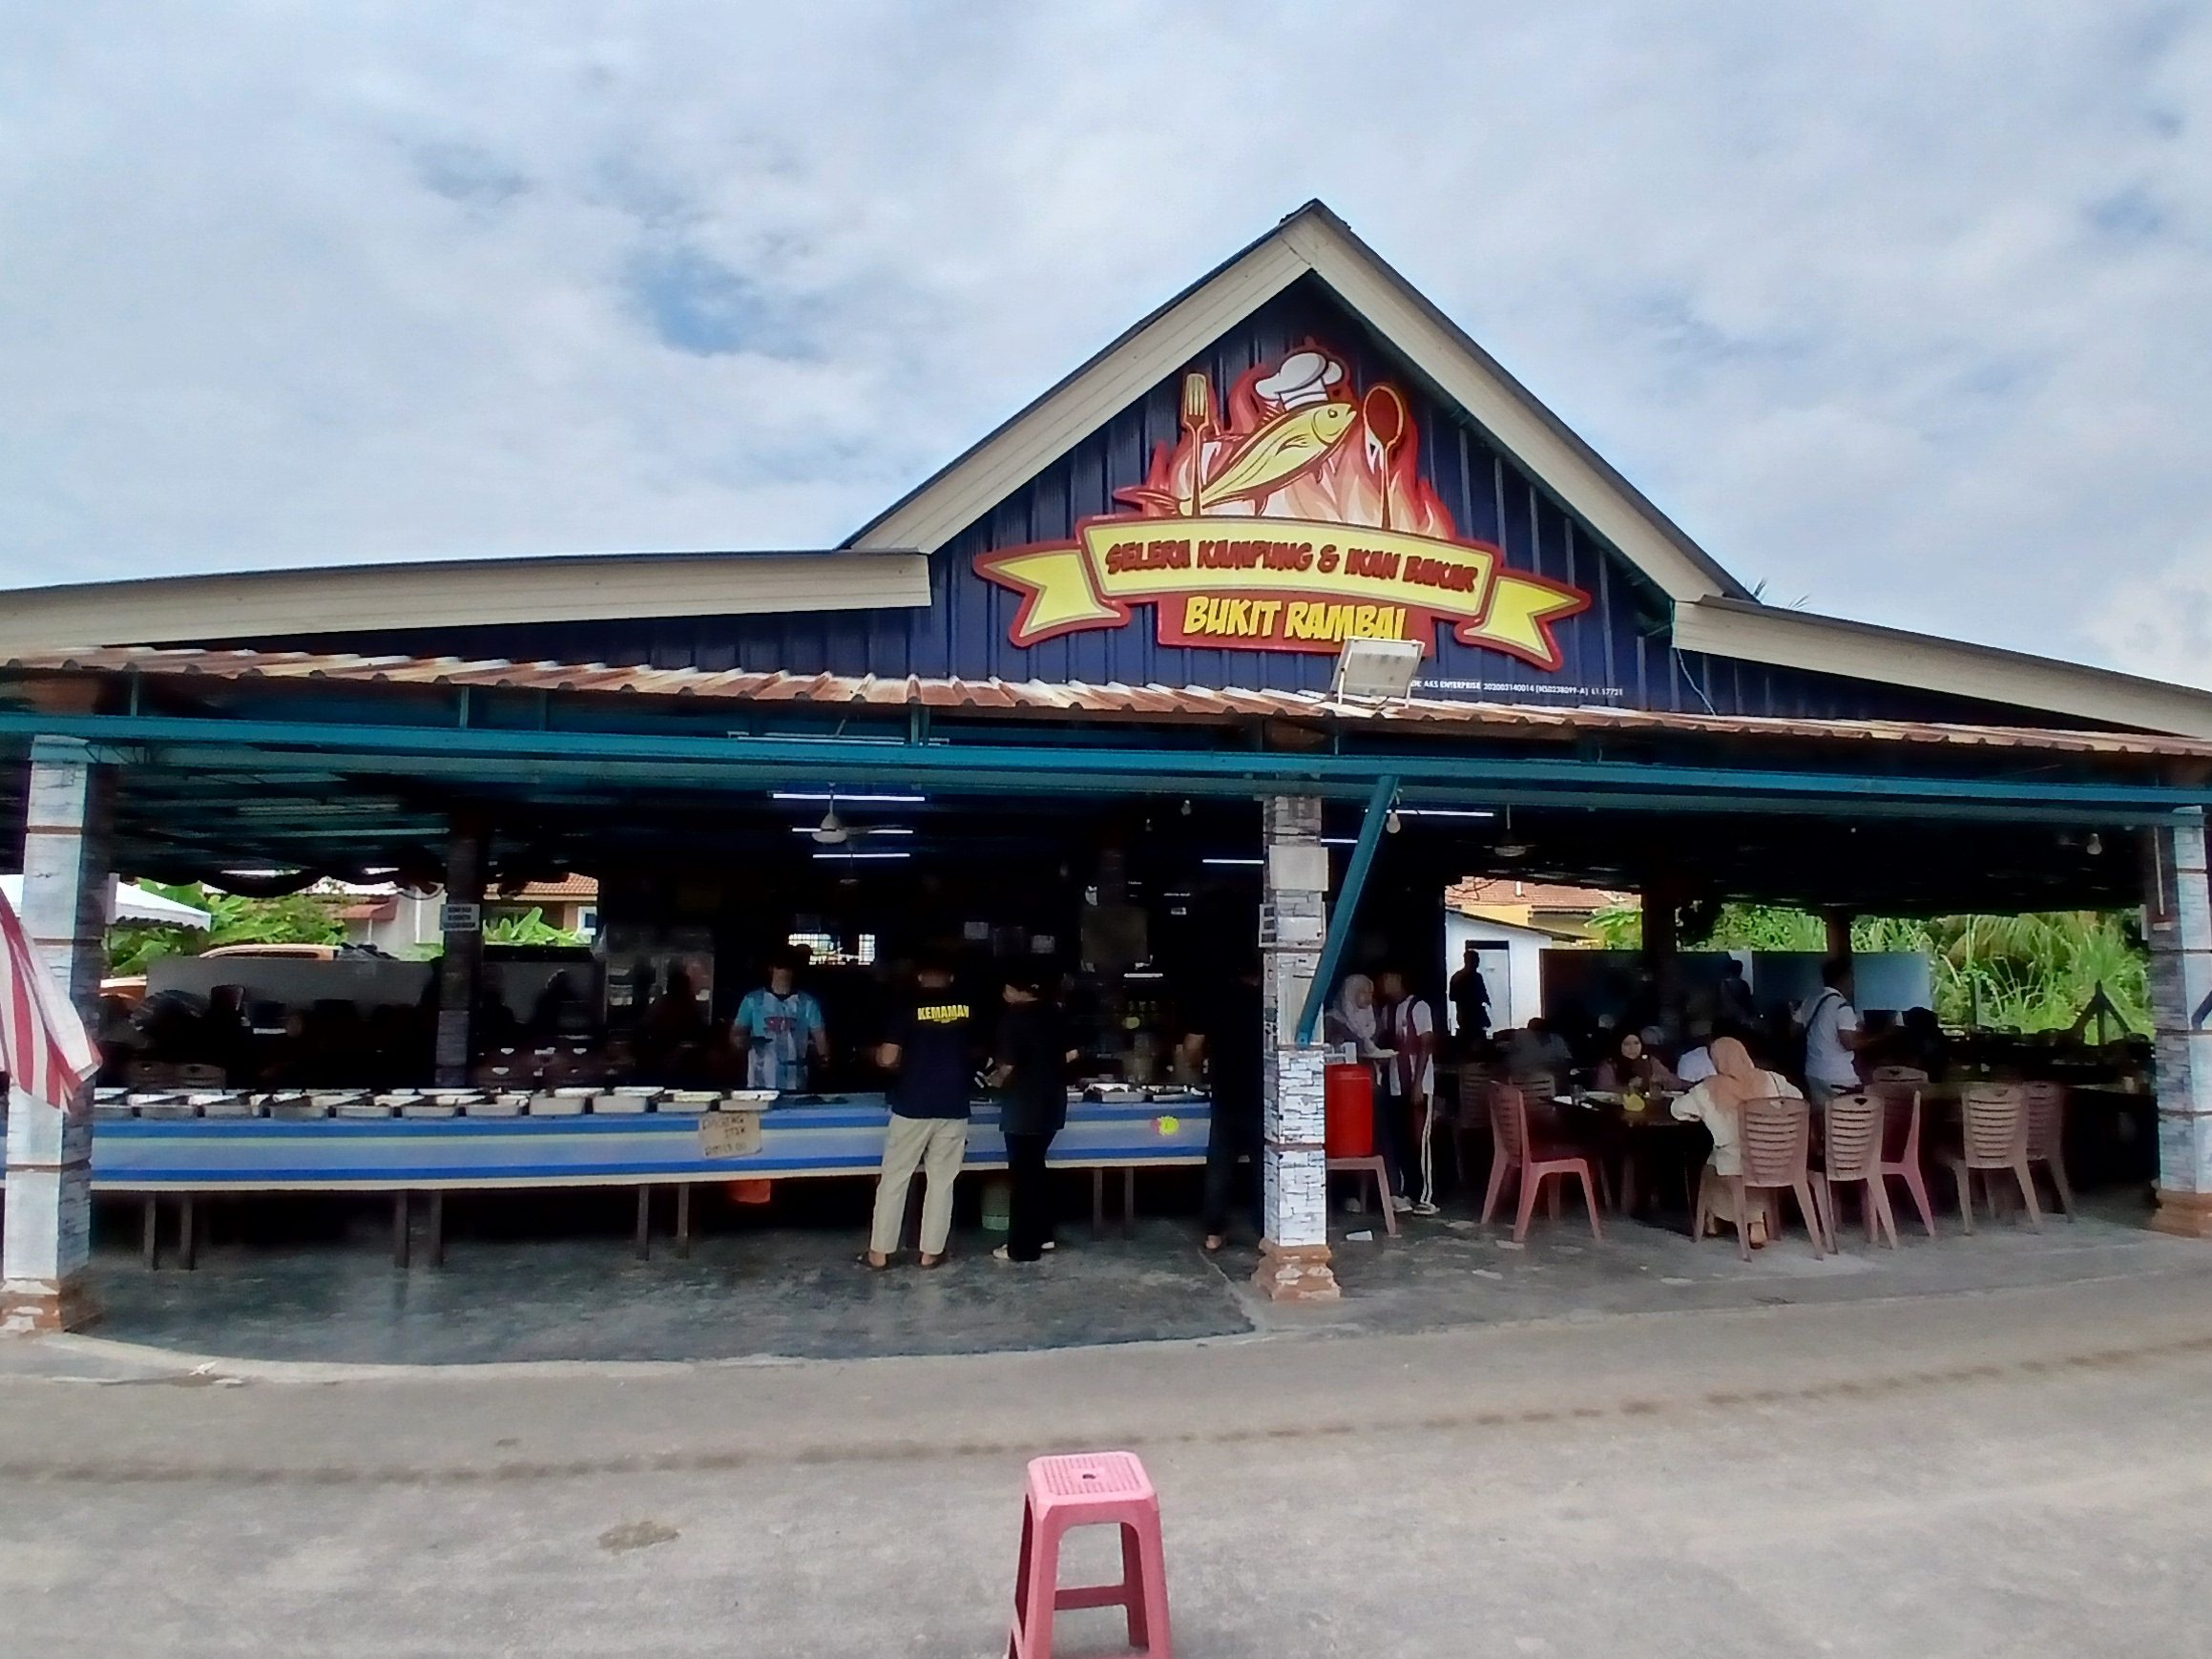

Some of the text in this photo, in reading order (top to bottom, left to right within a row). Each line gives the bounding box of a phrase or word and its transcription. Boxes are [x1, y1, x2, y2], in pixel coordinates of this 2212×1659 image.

[1105, 539, 1478, 593] SELERA KAMPUNG & IKAN BAKAR
[1182, 596, 1407, 642] BUKIT RAMBAI
[1439, 681, 1481, 690] ENTERPRISE
[917, 1004, 970, 1020] KEMAMAN
